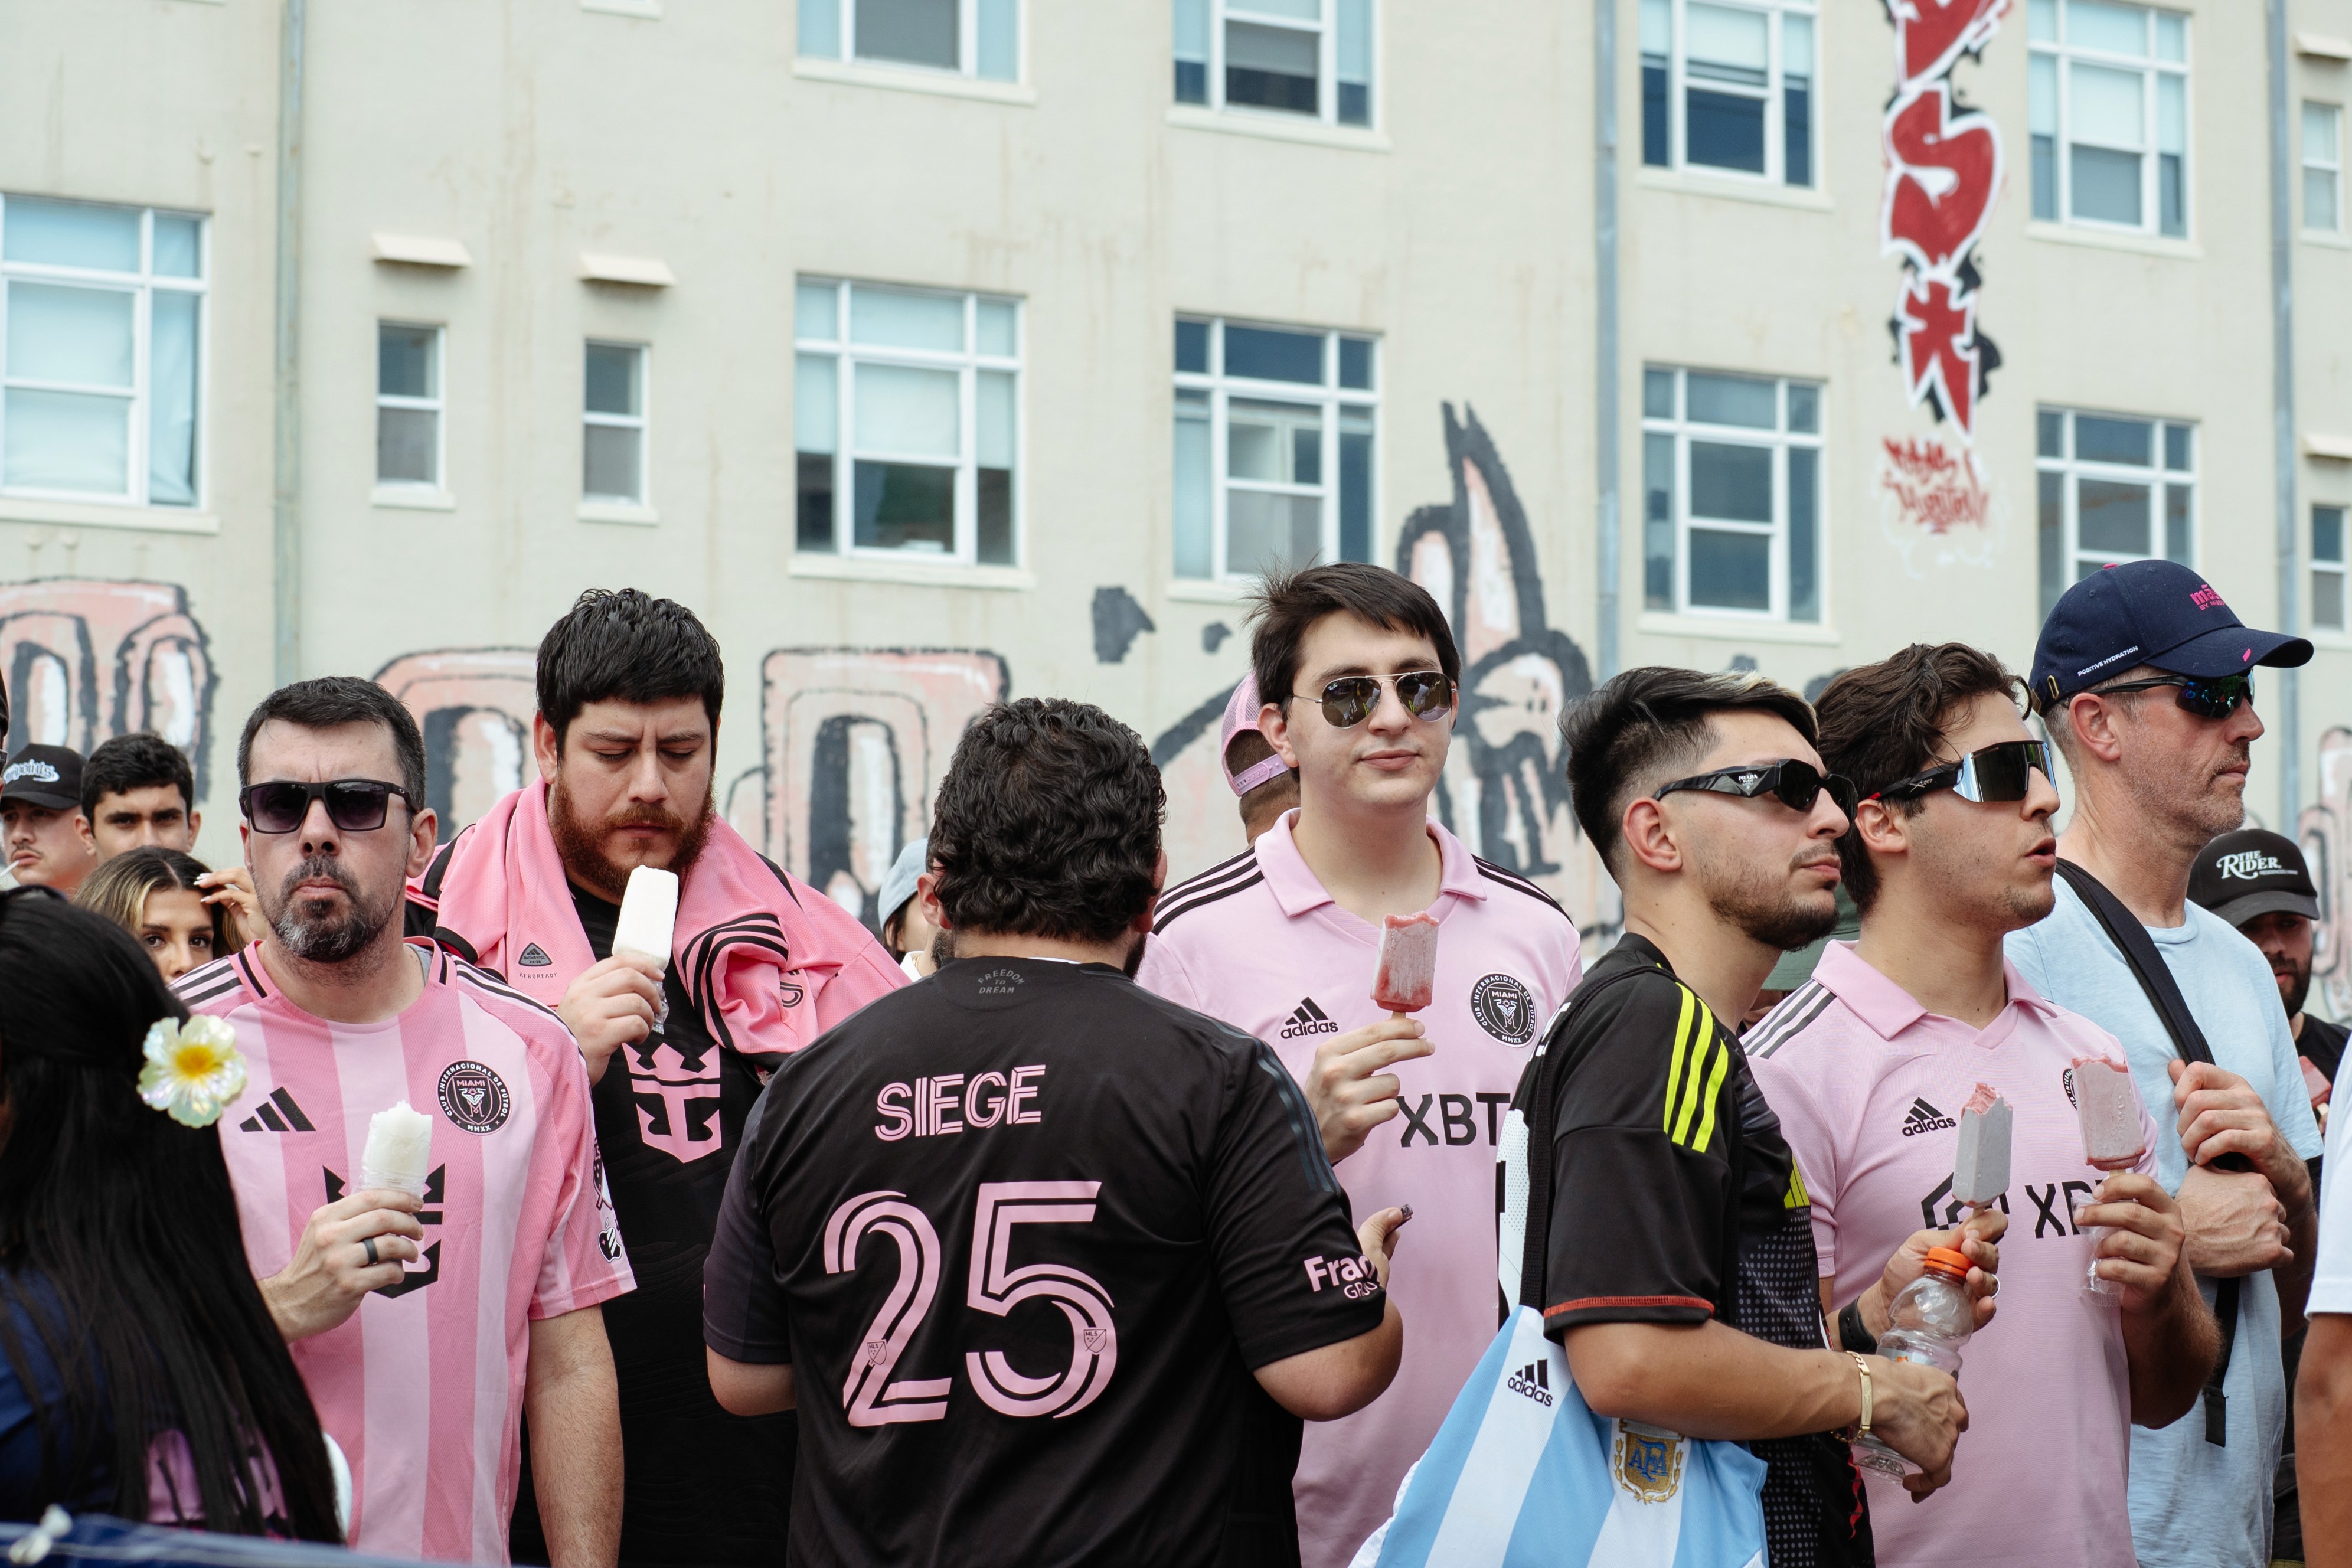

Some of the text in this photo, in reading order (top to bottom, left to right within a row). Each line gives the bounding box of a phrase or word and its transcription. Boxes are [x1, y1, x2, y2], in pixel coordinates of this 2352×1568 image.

[2077, 646, 2138, 677] POSITIVE HYDRATION
[2237, 850, 2262, 861] THE
[978, 969, 1025, 985] FREEDOM
[1474, 975, 1522, 1004] INTERNACIONAL
[1491, 991, 1517, 999] MIAMI
[1523, 991, 1531, 1001] DE
[1474, 1007, 1488, 1027] CLUB
[1280, 1021, 1338, 1039] adidas
[1502, 1034, 1522, 1043] MMXX
[439, 1063, 492, 1092] INTERNACIONAL
[493, 1076, 502, 1087] DE
[440, 1096, 453, 1116] CLUB
[875, 1064, 1046, 1141] SIEGE
[467, 1124, 491, 1132] MMXX
[1902, 1118, 1956, 1137] adidas
[824, 1181, 1117, 1427] 25
[1508, 1377, 1553, 1407] adidas
[1628, 1437, 1668, 1483] AFA
